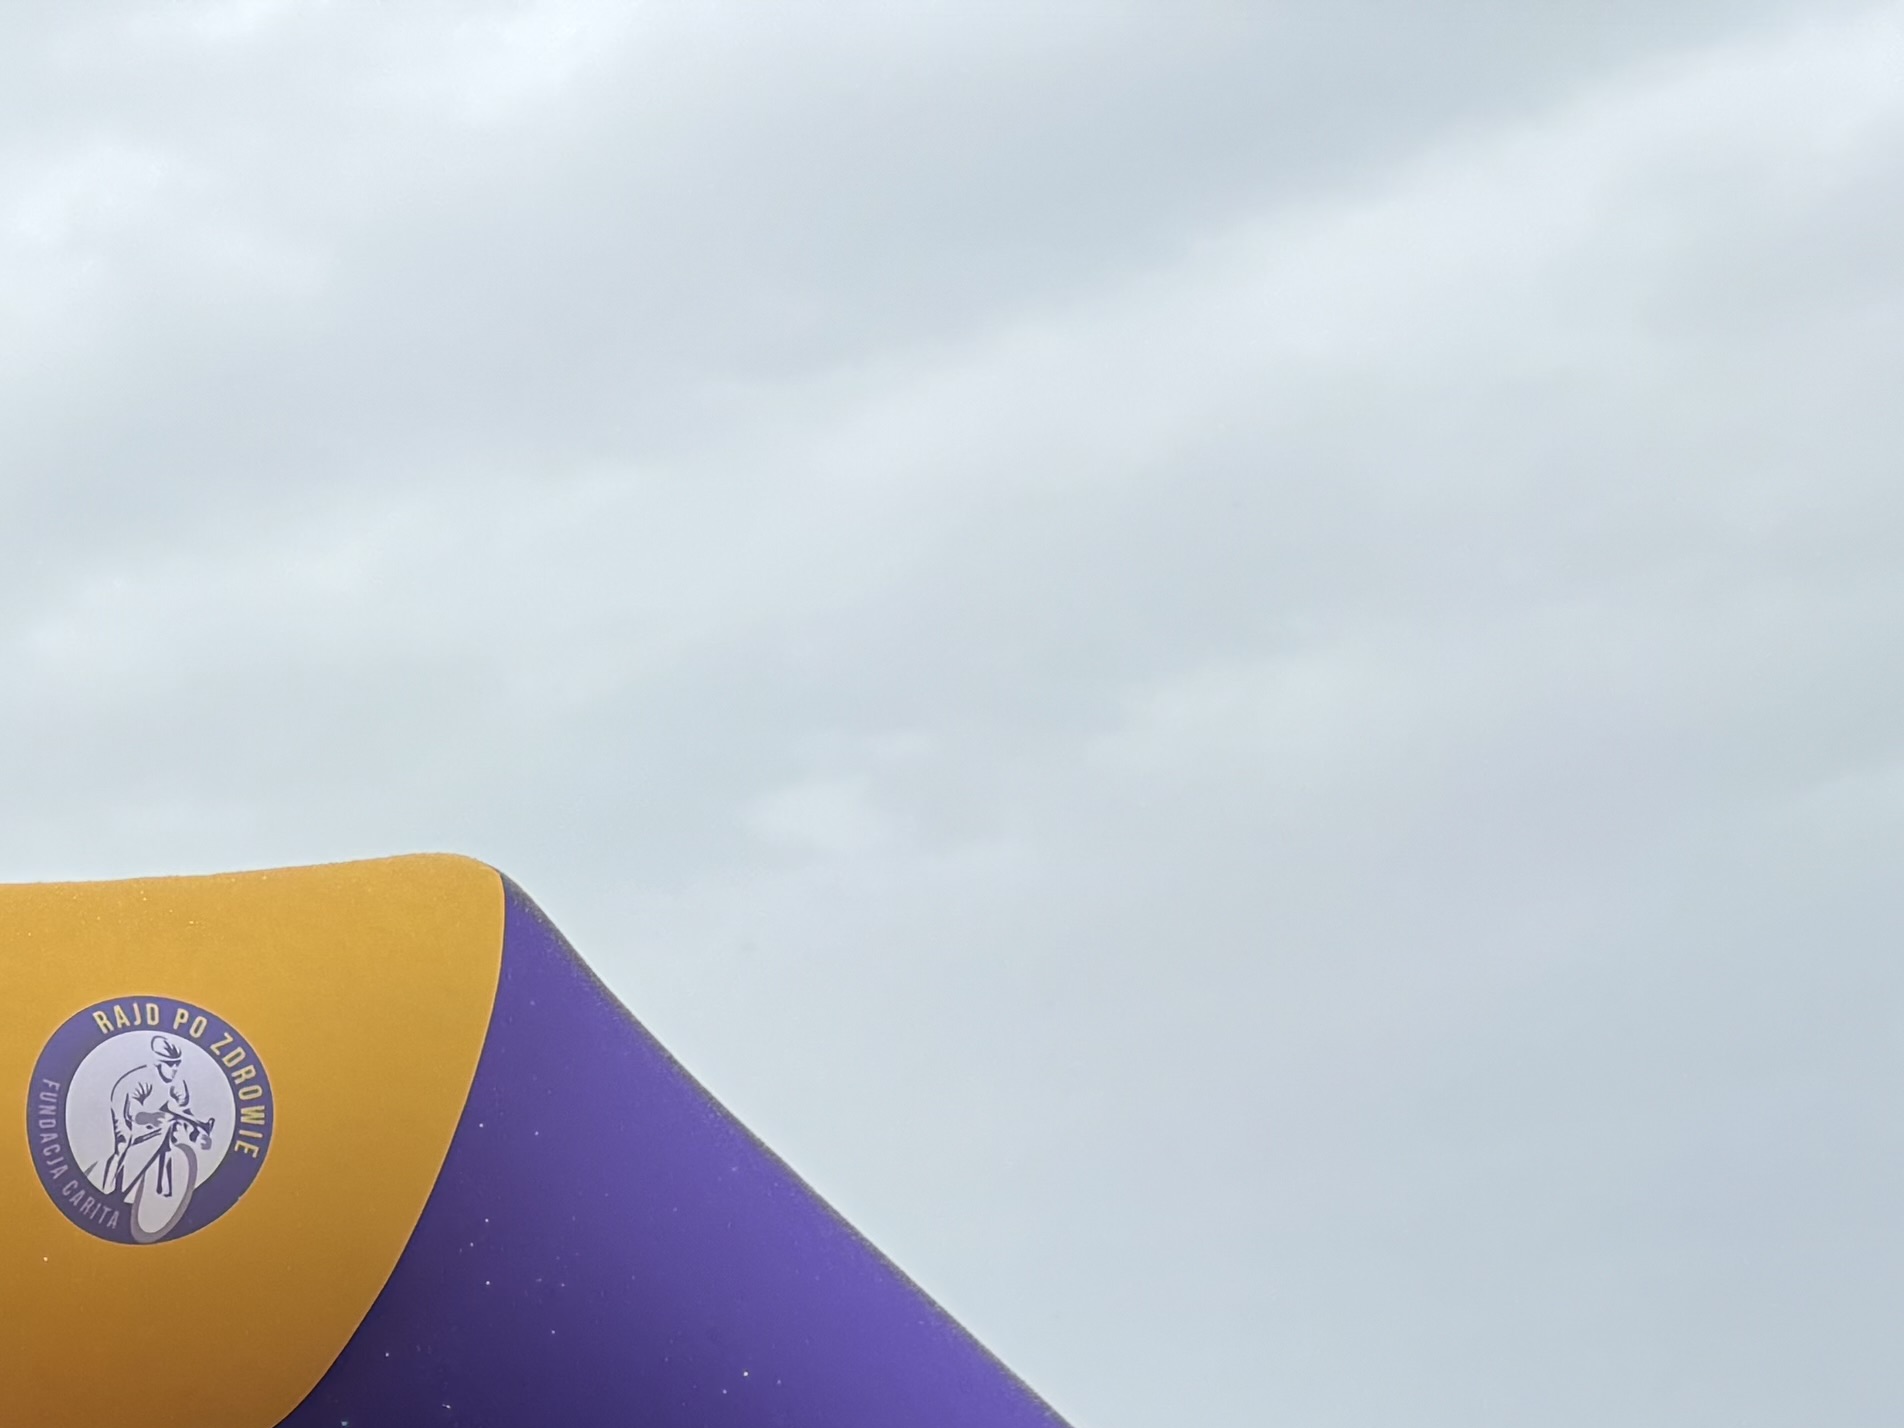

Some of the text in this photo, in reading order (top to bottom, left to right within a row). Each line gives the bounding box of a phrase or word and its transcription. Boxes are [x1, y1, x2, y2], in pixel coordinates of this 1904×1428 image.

[37, 1078, 122, 1230] FUNDACJA CARITA
[92, 1002, 266, 1159] RAJD PO ZDROWIE
